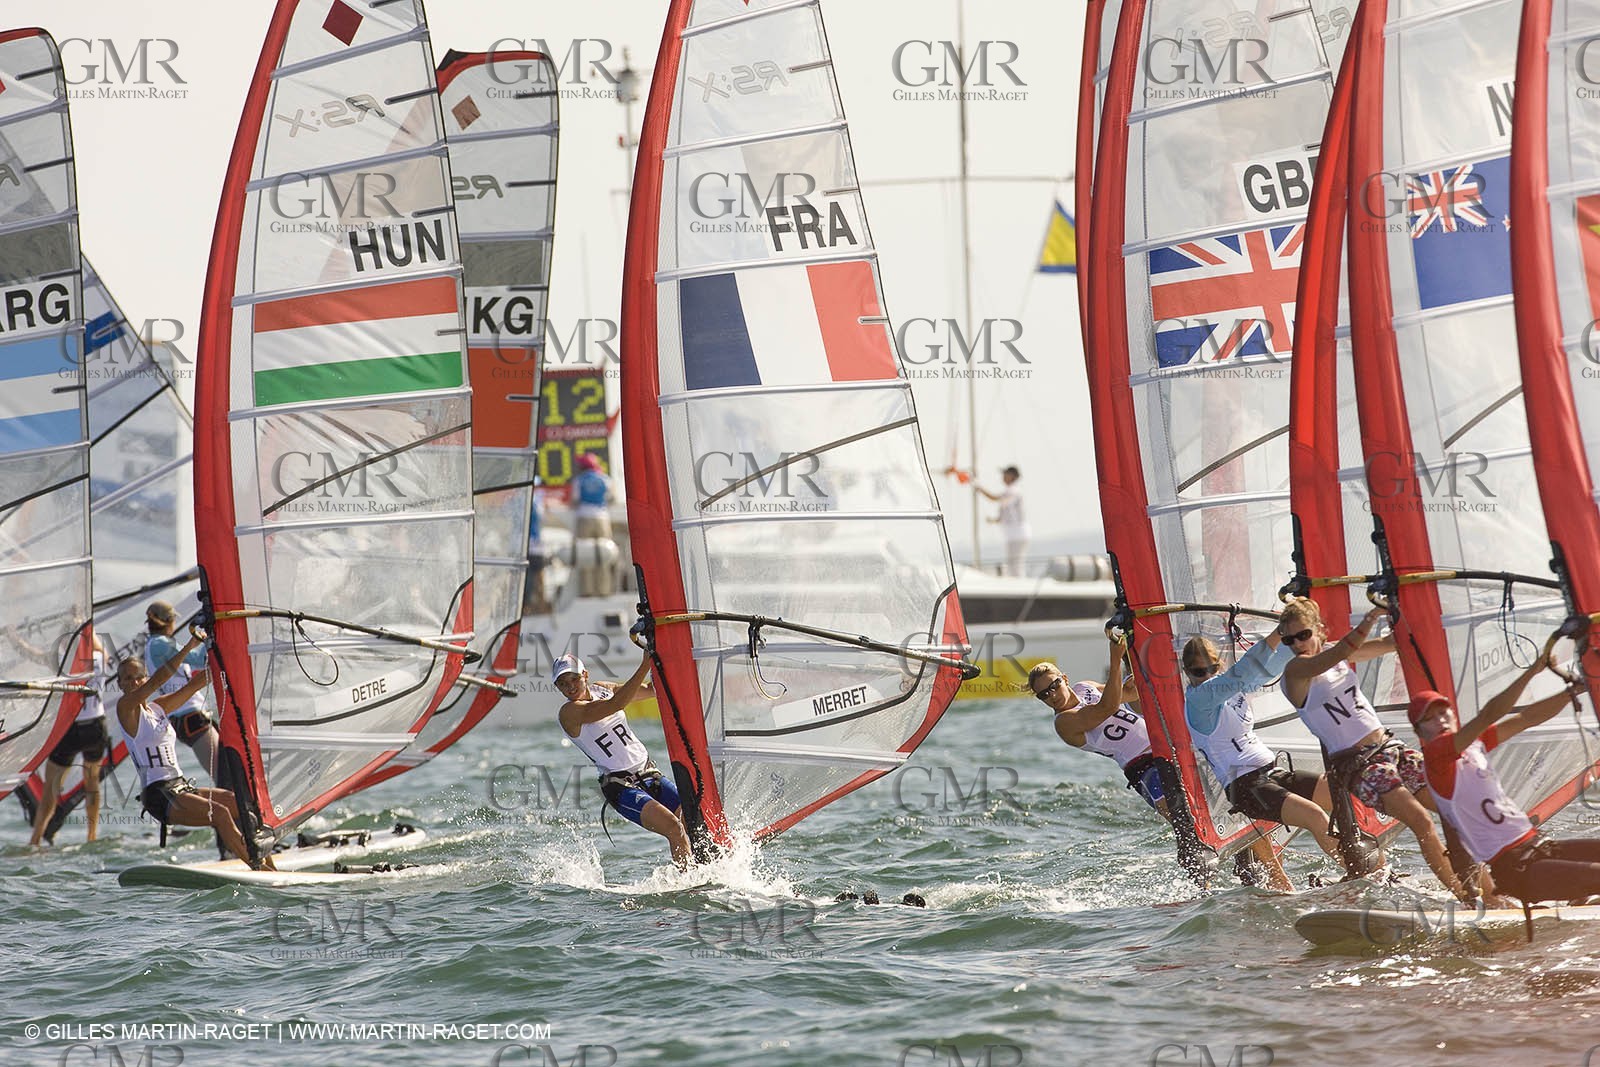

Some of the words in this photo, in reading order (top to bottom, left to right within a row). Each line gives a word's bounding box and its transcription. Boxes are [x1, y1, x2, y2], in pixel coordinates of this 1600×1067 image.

[1243, 156, 1320, 214] GB
[348, 219, 446, 272] HUN
[765, 201, 858, 252] FRA
[0, 282, 71, 333] RG
[464, 295, 534, 335] KG
[541, 378, 606, 426] 12
[352, 678, 387, 704] DETRE
[812, 685, 867, 716] MERRET
[594, 723, 633, 759] FR
[1103, 709, 1139, 741] GB
